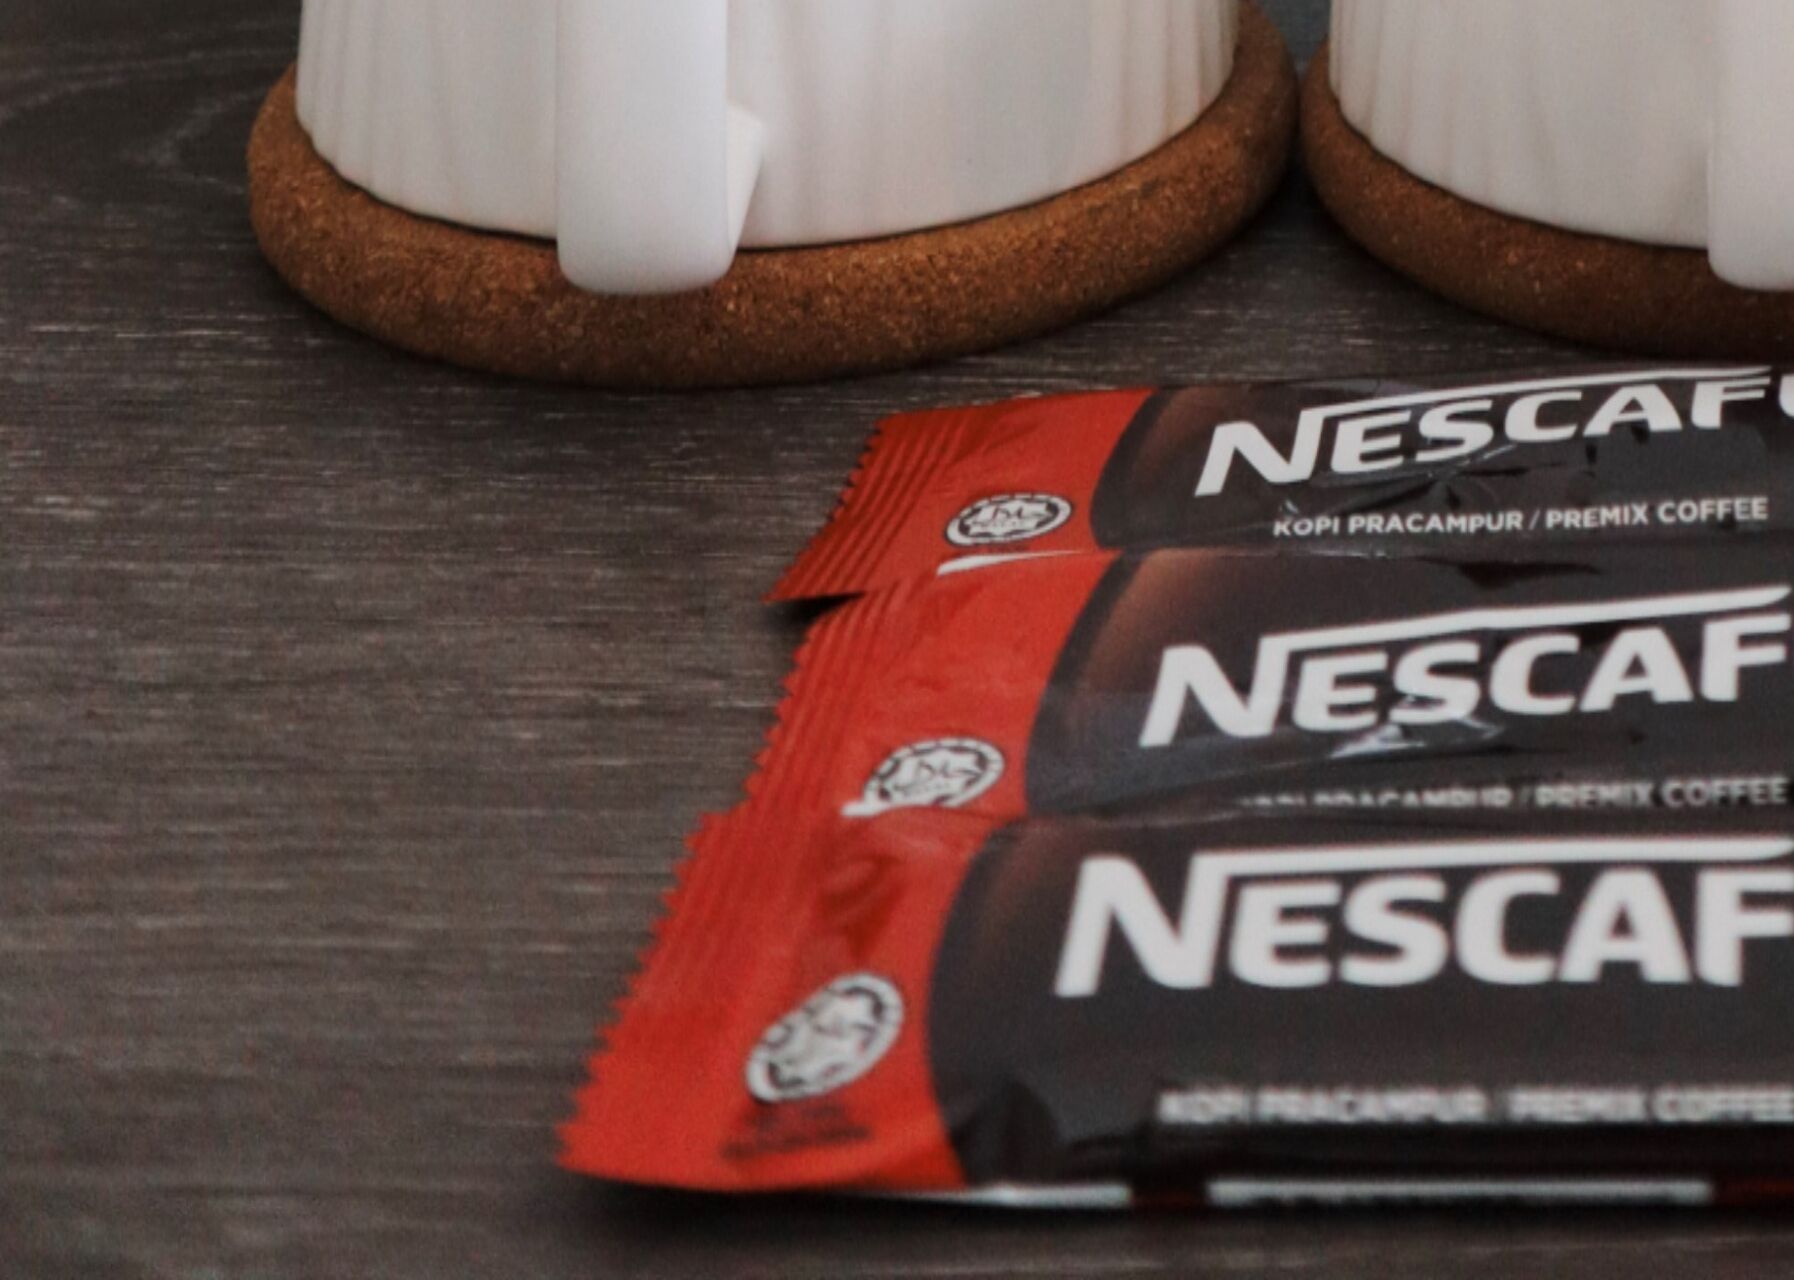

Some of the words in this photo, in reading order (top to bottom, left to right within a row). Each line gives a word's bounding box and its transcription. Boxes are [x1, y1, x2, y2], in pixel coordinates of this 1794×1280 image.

[1272, 512, 1340, 538] KOPI
[1348, 509, 1523, 535] PRACAMPUR
[1545, 504, 1650, 531] PREMIX
[1657, 497, 1769, 524] COFFEE
[1534, 781, 1653, 809] PREMIX
[1662, 777, 1791, 807] COFFEE
